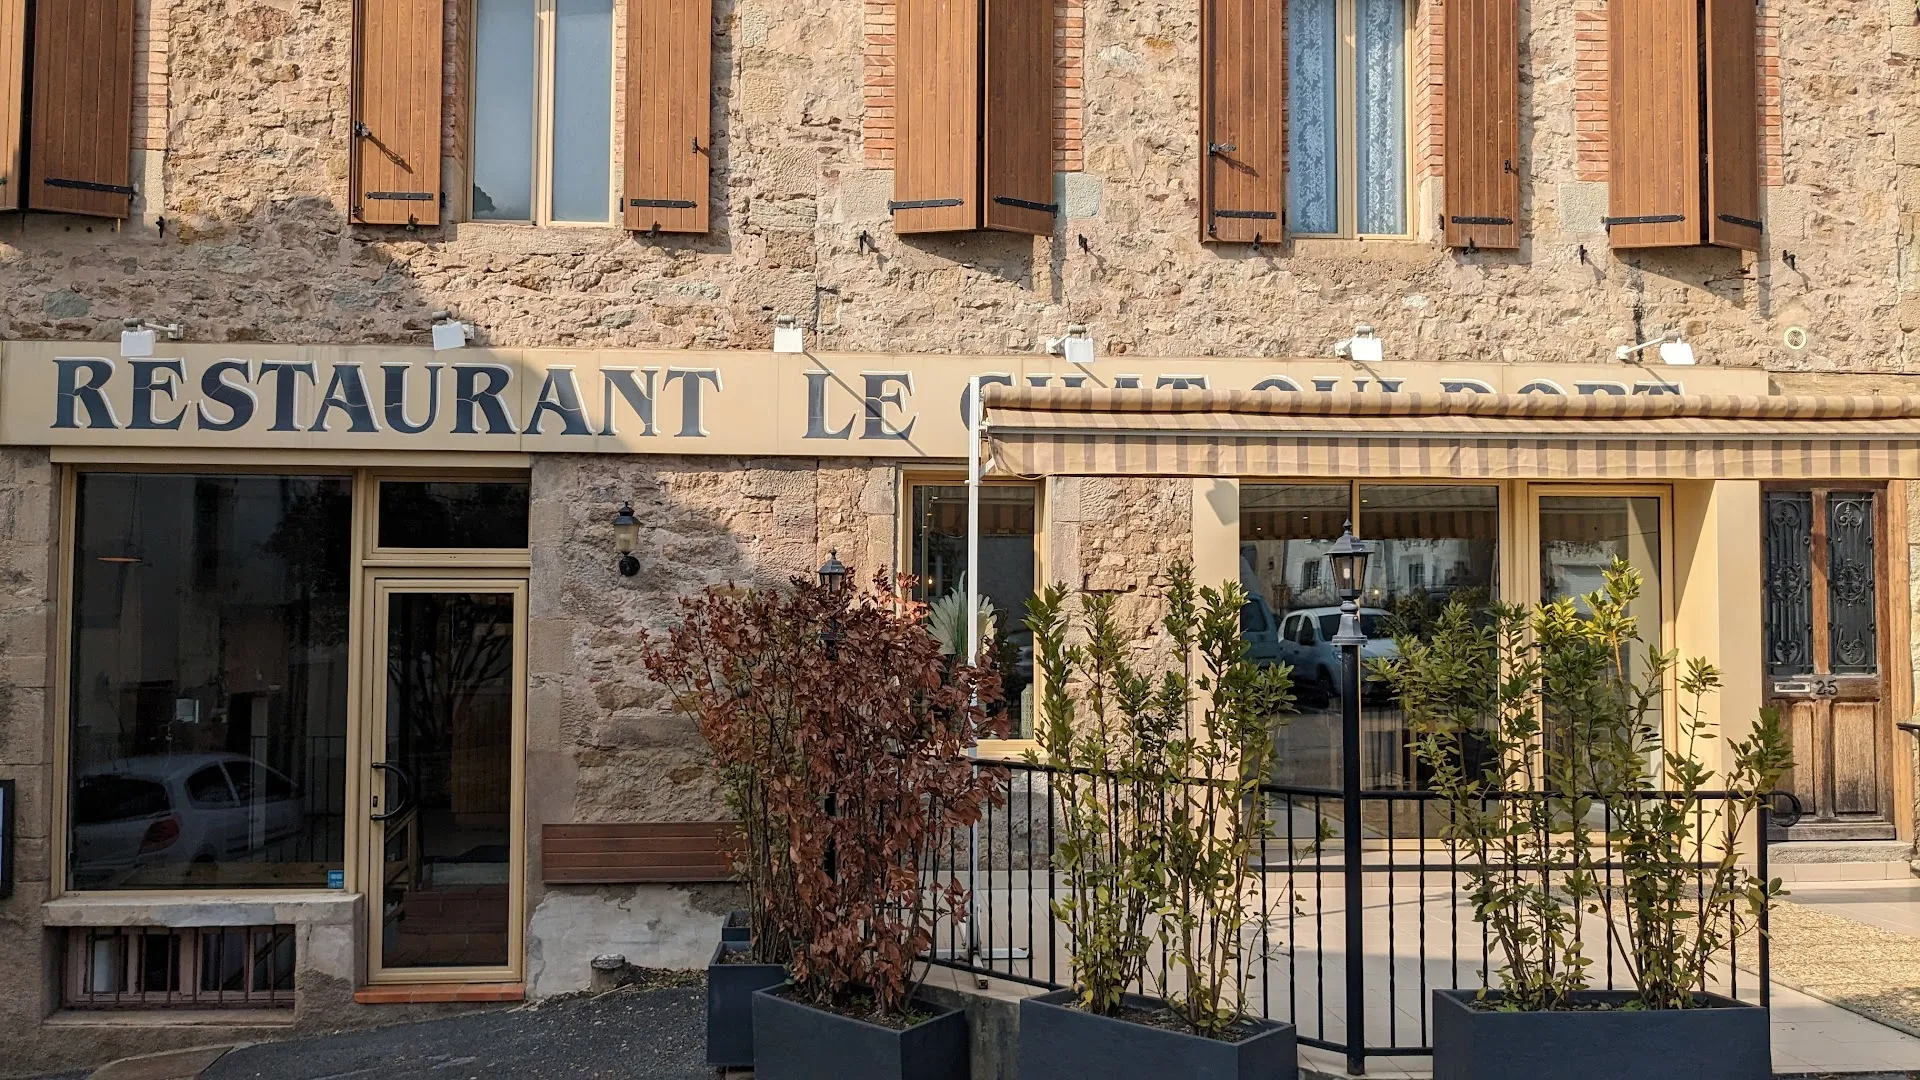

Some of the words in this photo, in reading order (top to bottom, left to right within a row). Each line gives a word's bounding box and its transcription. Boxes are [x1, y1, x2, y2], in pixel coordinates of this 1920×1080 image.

[50, 356, 723, 439] RESTAURANT
[801, 369, 920, 441] LE
[1815, 679, 1839, 696] 25
